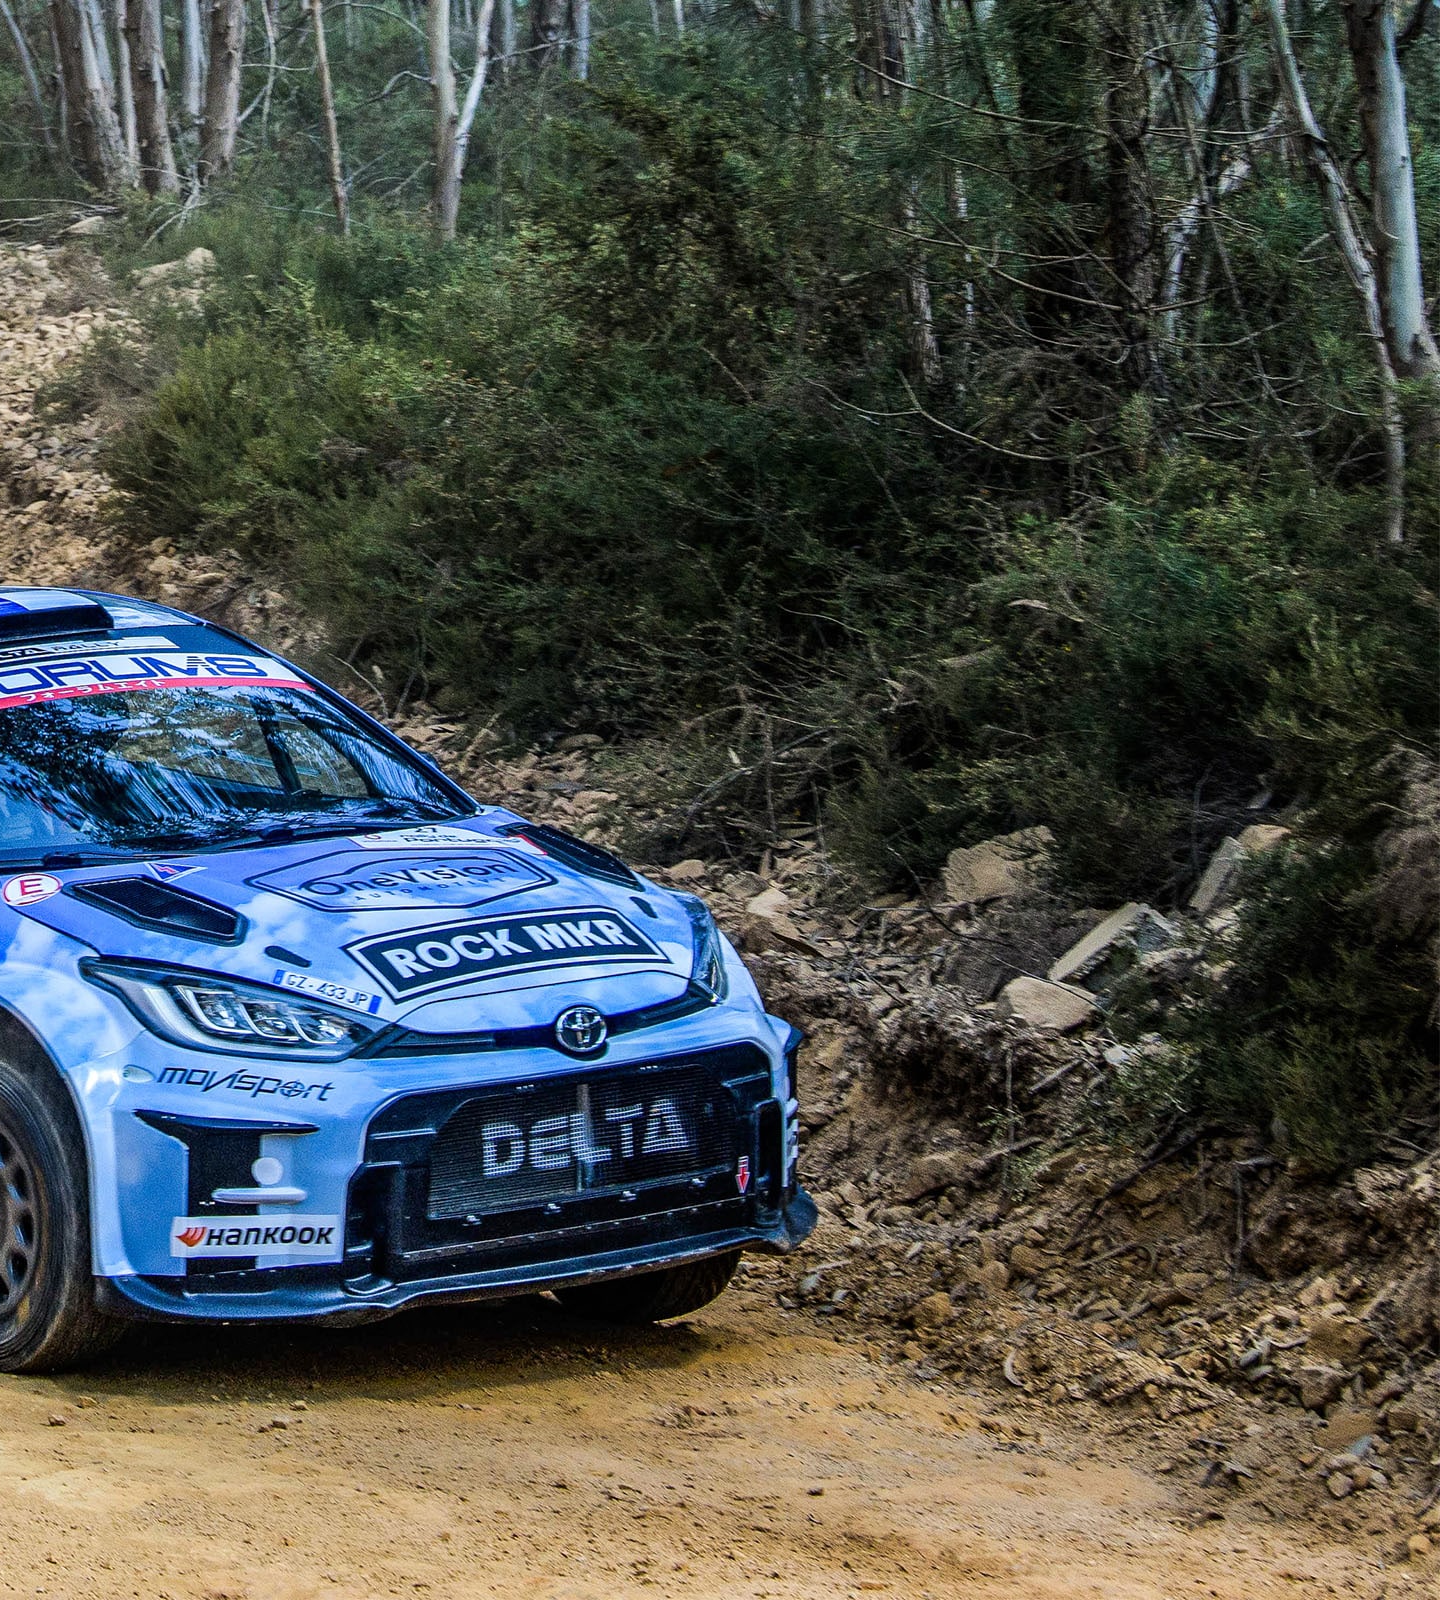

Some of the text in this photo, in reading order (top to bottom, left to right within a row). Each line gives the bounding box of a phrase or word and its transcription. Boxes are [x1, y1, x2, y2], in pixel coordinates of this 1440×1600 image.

[19, 679, 166, 702] フォーラムエイト
[20, 878, 42, 895] E
[304, 862, 516, 896] OneVision
[381, 918, 638, 979] ROCK MKR
[287, 974, 308, 989] GZ
[316, 982, 347, 1000] 433
[157, 1067, 336, 1101] movisport
[481, 1098, 691, 1177] DELTA
